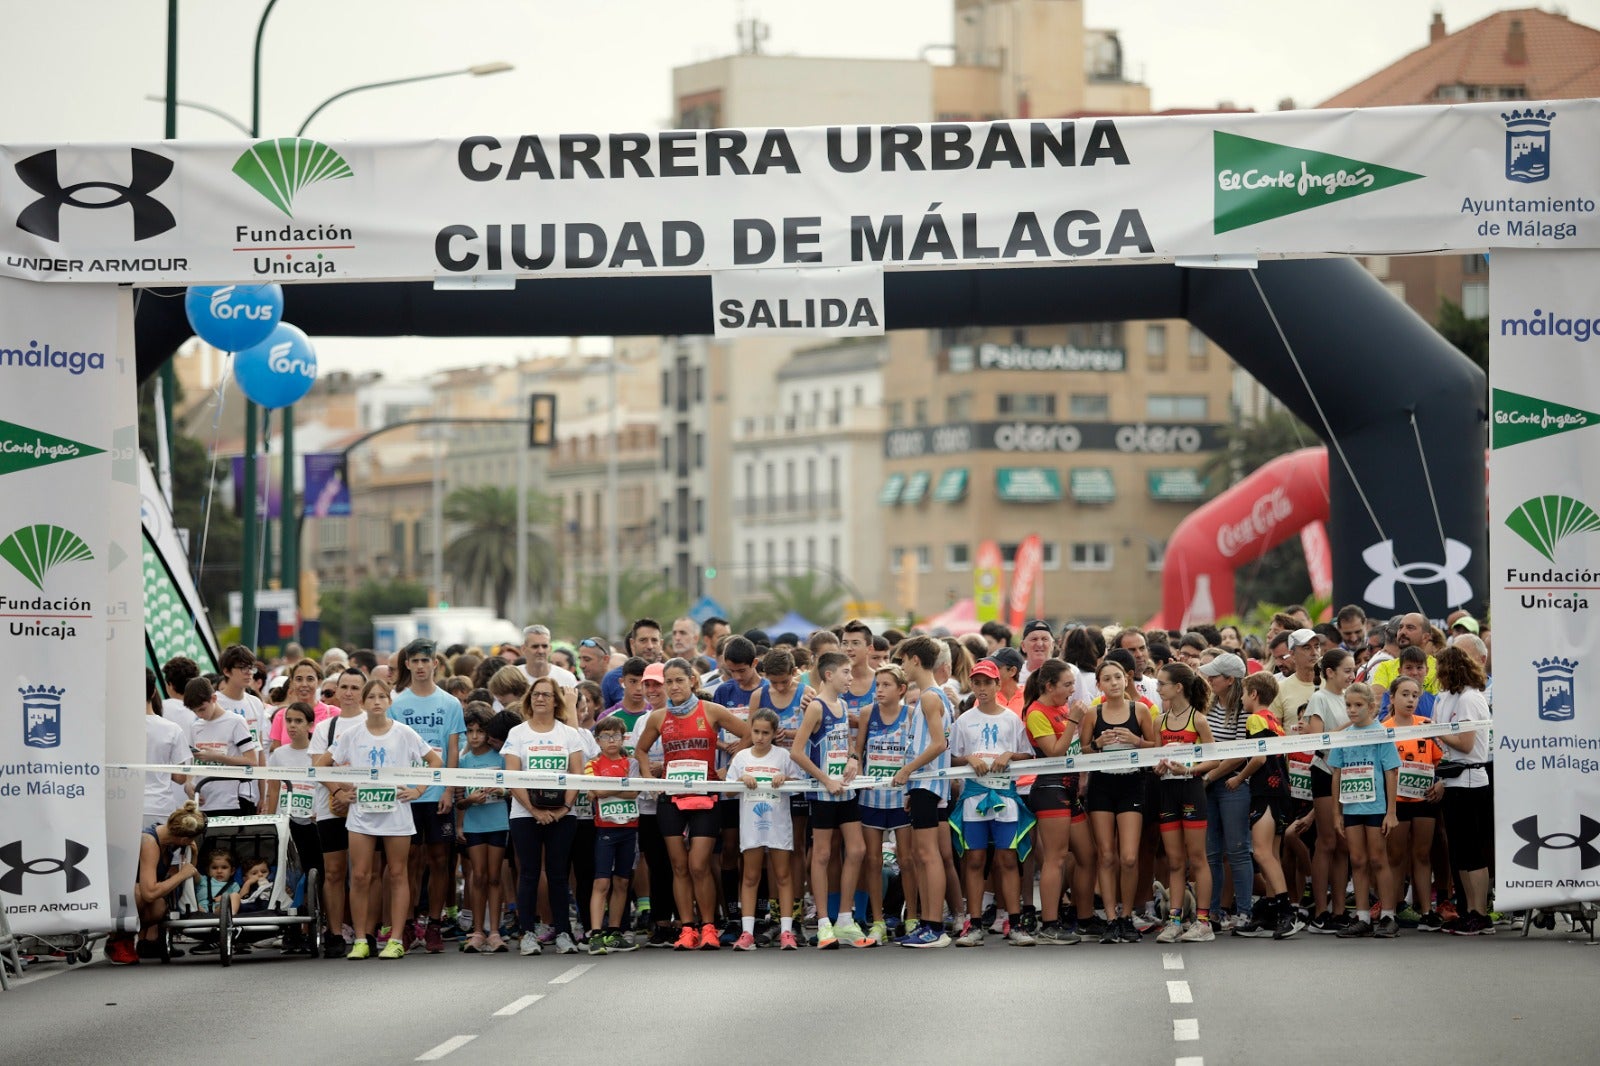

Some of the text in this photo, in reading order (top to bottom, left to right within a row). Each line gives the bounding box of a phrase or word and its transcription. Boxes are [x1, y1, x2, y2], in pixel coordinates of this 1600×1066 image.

[457, 119, 1131, 182] CARRERA URBANA
[1218, 161, 1375, 196] El Corte Inglés
[1461, 196, 1596, 216] Ayuntamiento
[235, 223, 353, 243] Fundación
[435, 202, 1155, 272] CIUDAD DE MÁLAGA
[1477, 219, 1578, 240] de Málaga
[7, 256, 189, 273] UNDER ARMOUR
[253, 253, 336, 278] Unicaja
[210, 285, 273, 321] Forus
[718, 297, 880, 329] SALIDA
[980, 343, 1124, 371] PsicoAbreu
[1495, 408, 1587, 428] El Corte Inglés
[994, 422, 1082, 452] otero
[1115, 422, 1201, 453] otero
[3, 440, 34, 455] Corte
[34, 438, 80, 459] Inglés
[1521, 593, 1589, 612] Unicaja
[9, 620, 77, 641] Unicaja
[405, 712, 444, 728] nerja
[530, 758, 566, 770] 21612
[1515, 753, 1599, 774] de Málaga
[1, 780, 85, 799] de Málaga
[1341, 780, 1372, 793] 22329
[1401, 775, 1432, 789] 22423
[280, 796, 312, 809] 2605
[359, 790, 394, 802] 20477
[602, 803, 637, 816] 20913
[1506, 880, 1553, 888] UNDER
[40, 901, 99, 913] ARMOUR
